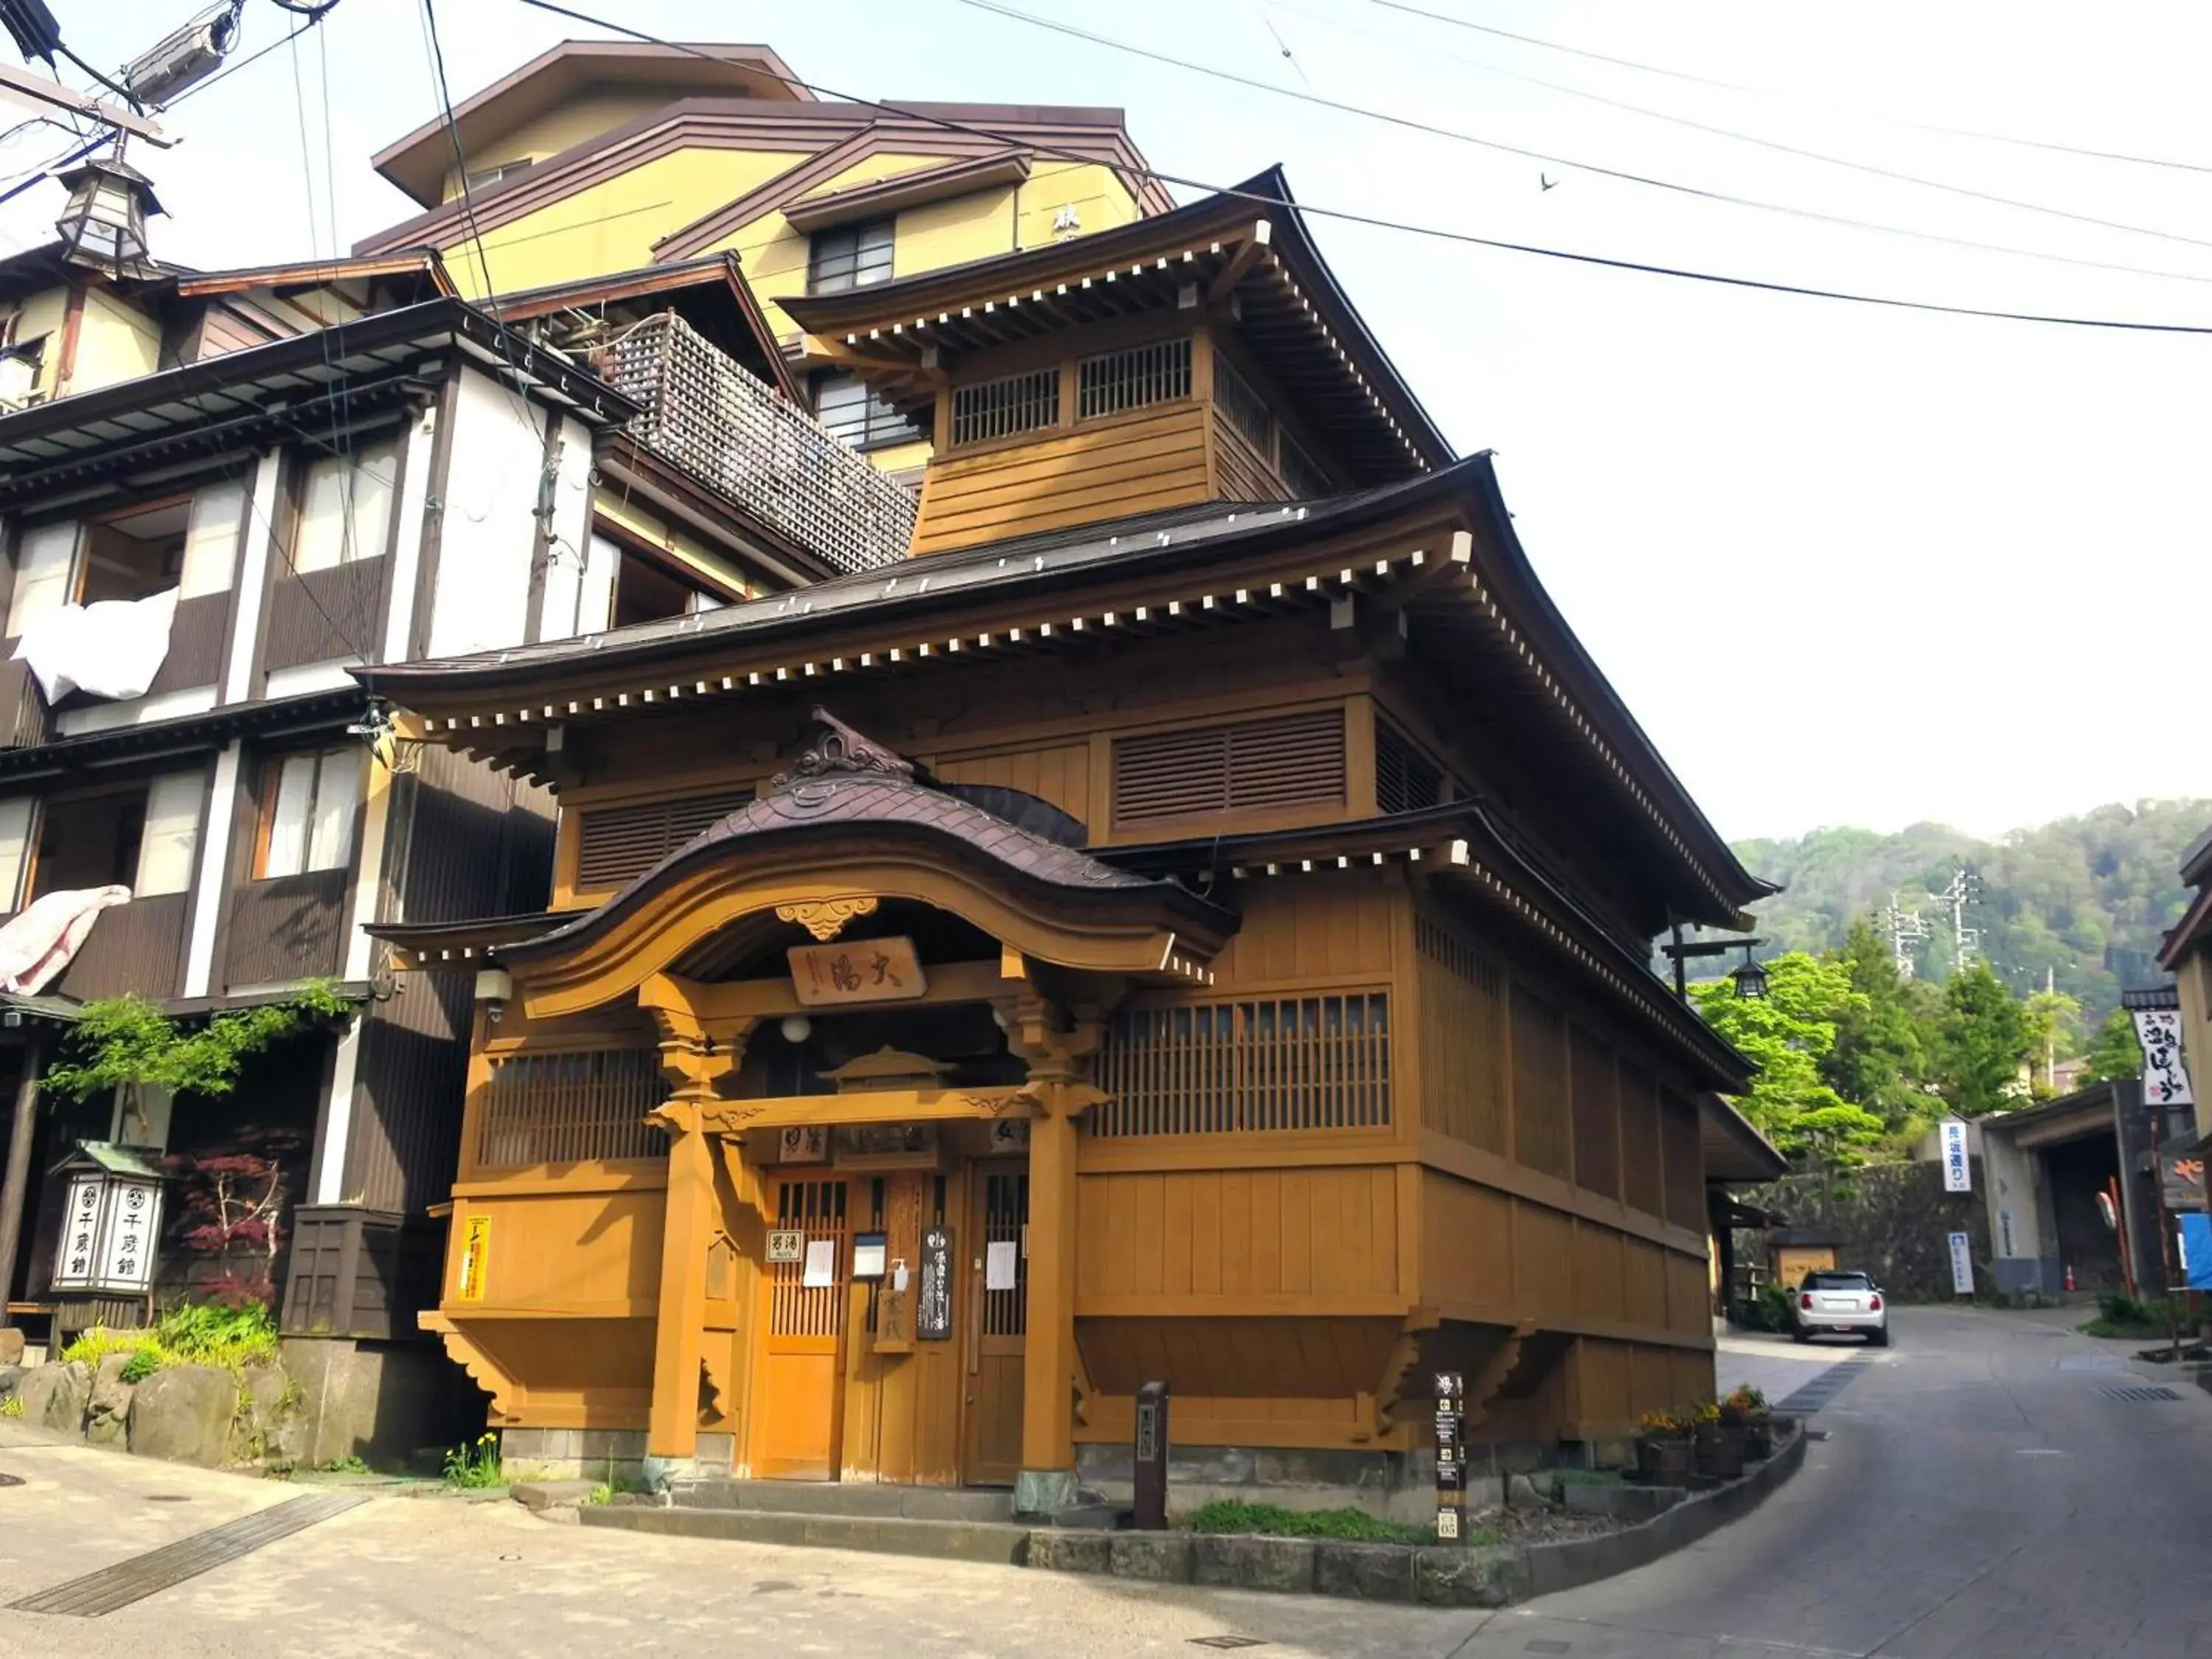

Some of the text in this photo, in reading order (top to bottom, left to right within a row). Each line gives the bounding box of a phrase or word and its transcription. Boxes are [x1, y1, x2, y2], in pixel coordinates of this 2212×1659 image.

[72, 1211, 94, 1274] 千歳館
[117, 1213, 142, 1276] 千歳館
[771, 1235, 797, 1251] 男湯
